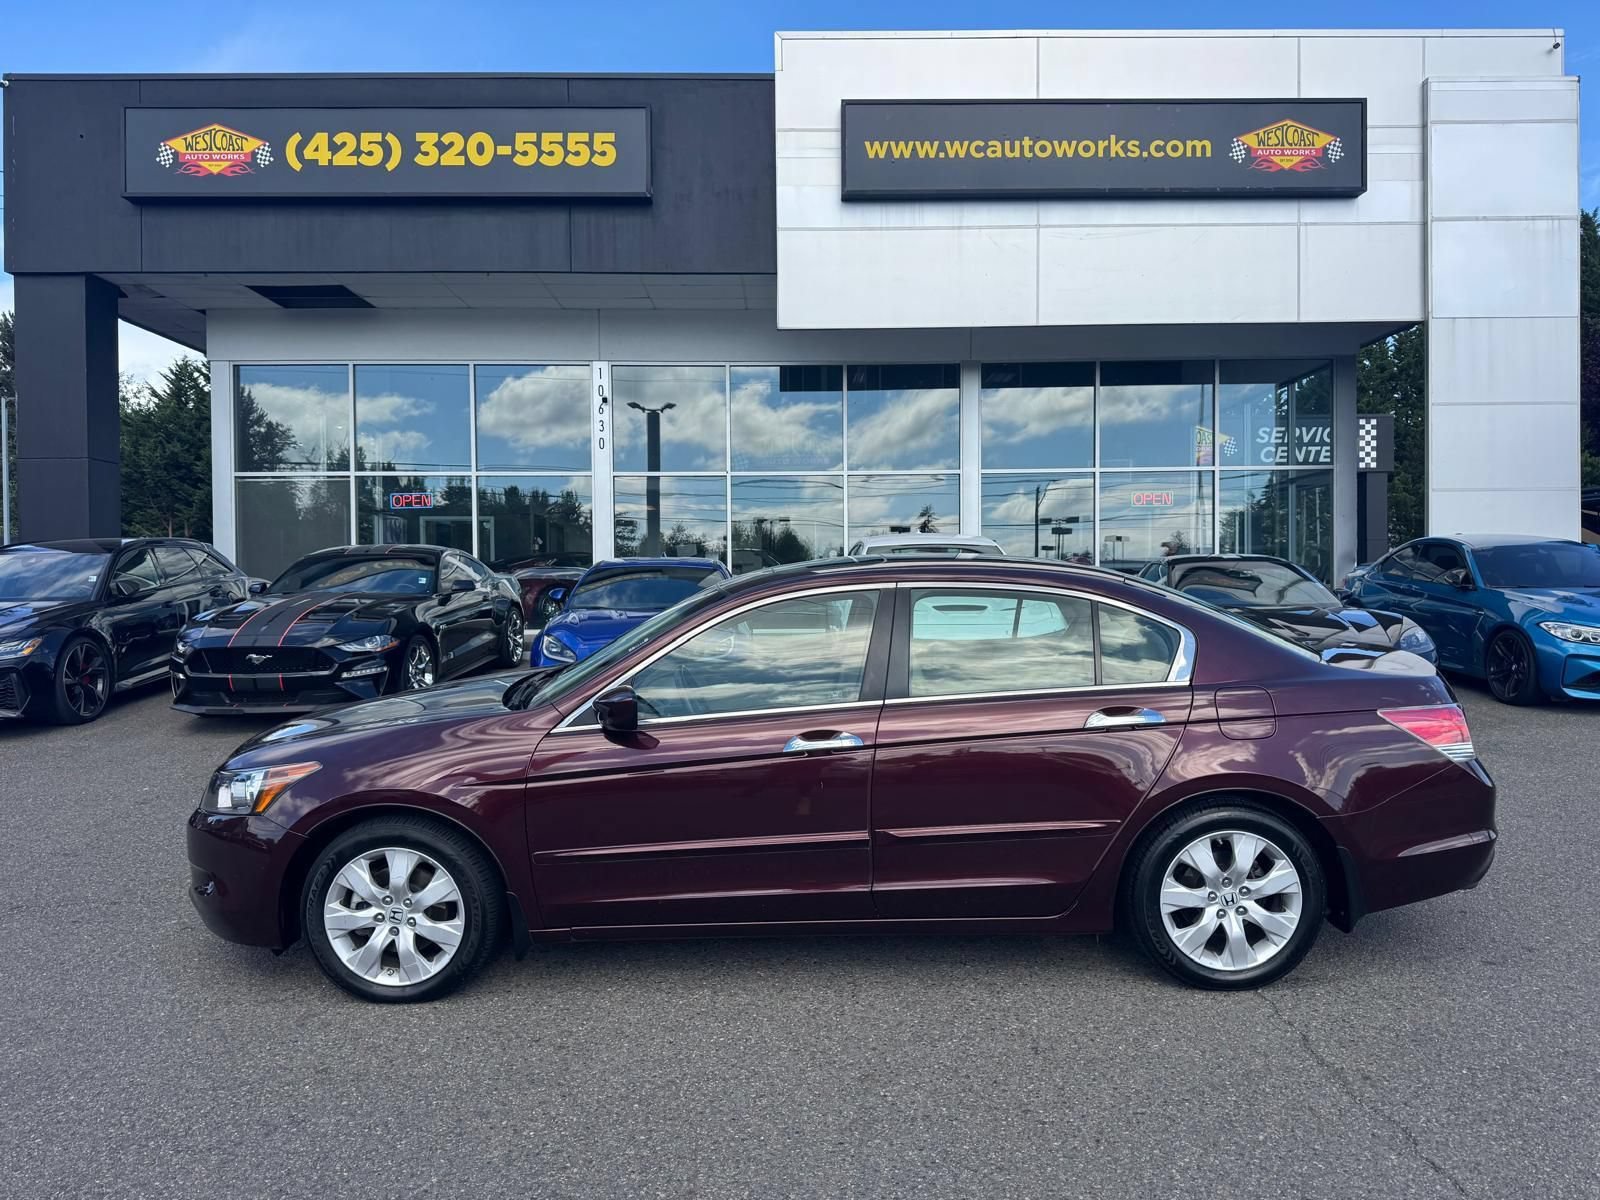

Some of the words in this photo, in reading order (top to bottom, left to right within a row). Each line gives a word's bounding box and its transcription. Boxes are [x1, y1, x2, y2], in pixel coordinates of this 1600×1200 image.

[285, 131, 402, 172] (425)
[414, 131, 617, 167] 320-5555
[864, 134, 1212, 160] www.wcautoworks.com
[1257, 148, 1281, 156] AUTO
[1284, 148, 1316, 156] WORKS
[185, 153, 210, 161] AUTO
[212, 153, 245, 161] WORKS
[392, 494, 432, 507] OPEN
[1133, 492, 1172, 506] OPEN
